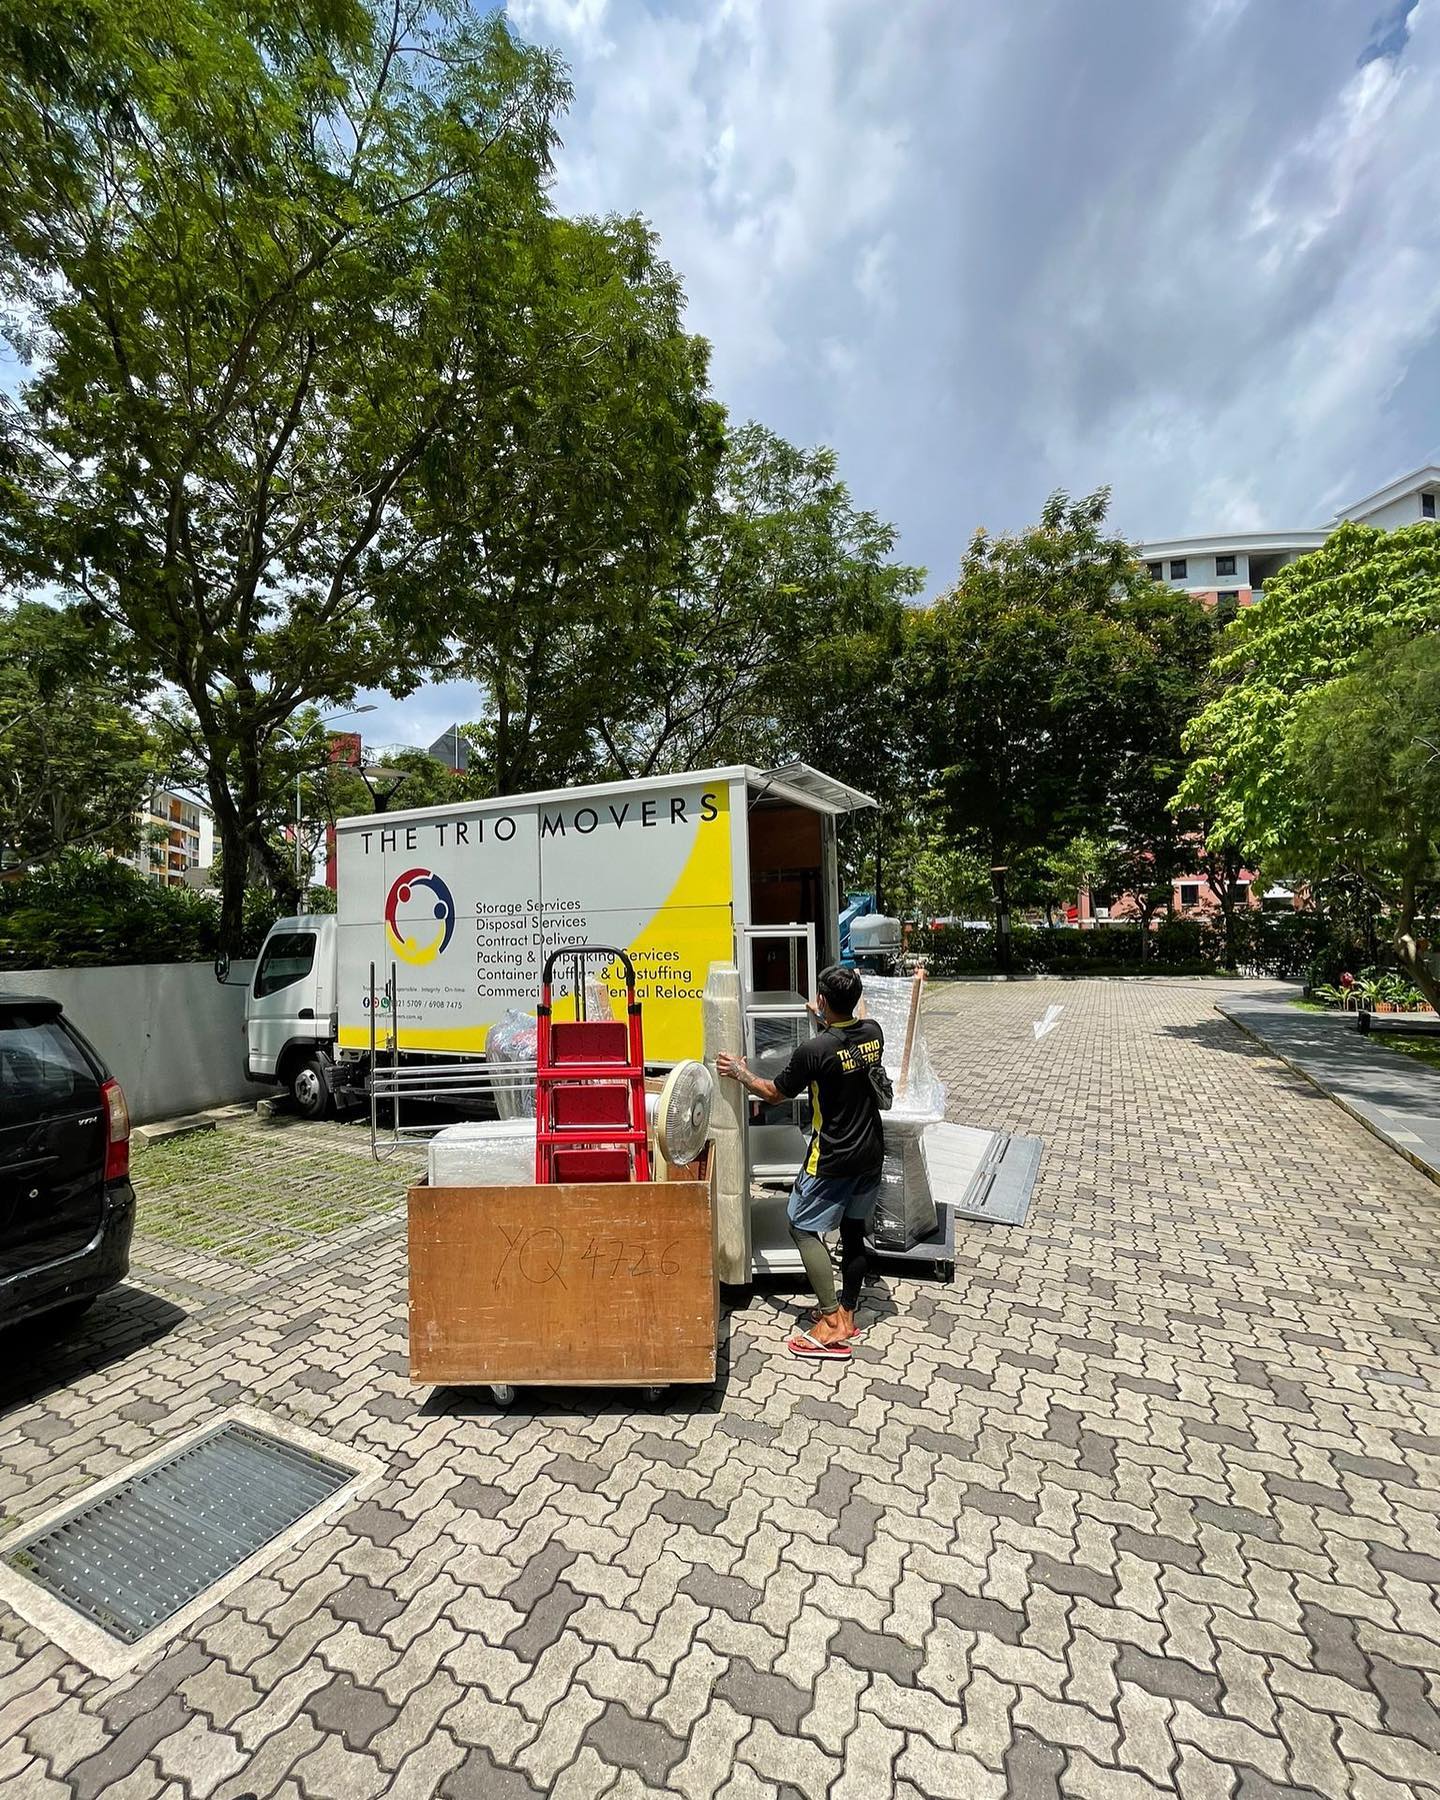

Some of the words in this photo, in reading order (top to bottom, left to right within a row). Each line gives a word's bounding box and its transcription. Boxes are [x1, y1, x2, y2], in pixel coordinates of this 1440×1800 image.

[361, 827, 417, 854] THE
[435, 816, 516, 847] TRIO
[541, 793, 718, 839] MOVERS
[475, 902, 522, 916] Storage
[526, 898, 581, 912] Services
[476, 916, 527, 932] Disposal
[531, 915, 587, 929] Services
[476, 935, 528, 947] Contract
[532, 932, 589, 946] Delivery
[477, 951, 522, 966] Packing
[527, 950, 536, 963] &
[476, 967, 538, 980] Container
[601, 966, 611, 980] &
[616, 965, 692, 983] Ustuffing
[477, 984, 555, 998] Commercil
[559, 984, 569, 997] &
[655, 985, 704, 998] Reloca
[836, 1048, 854, 1061] TH
[857, 1039, 880, 1055] TRIO
[494, 1225, 568, 1292] YQ
[581, 1237, 681, 1280] 4726
